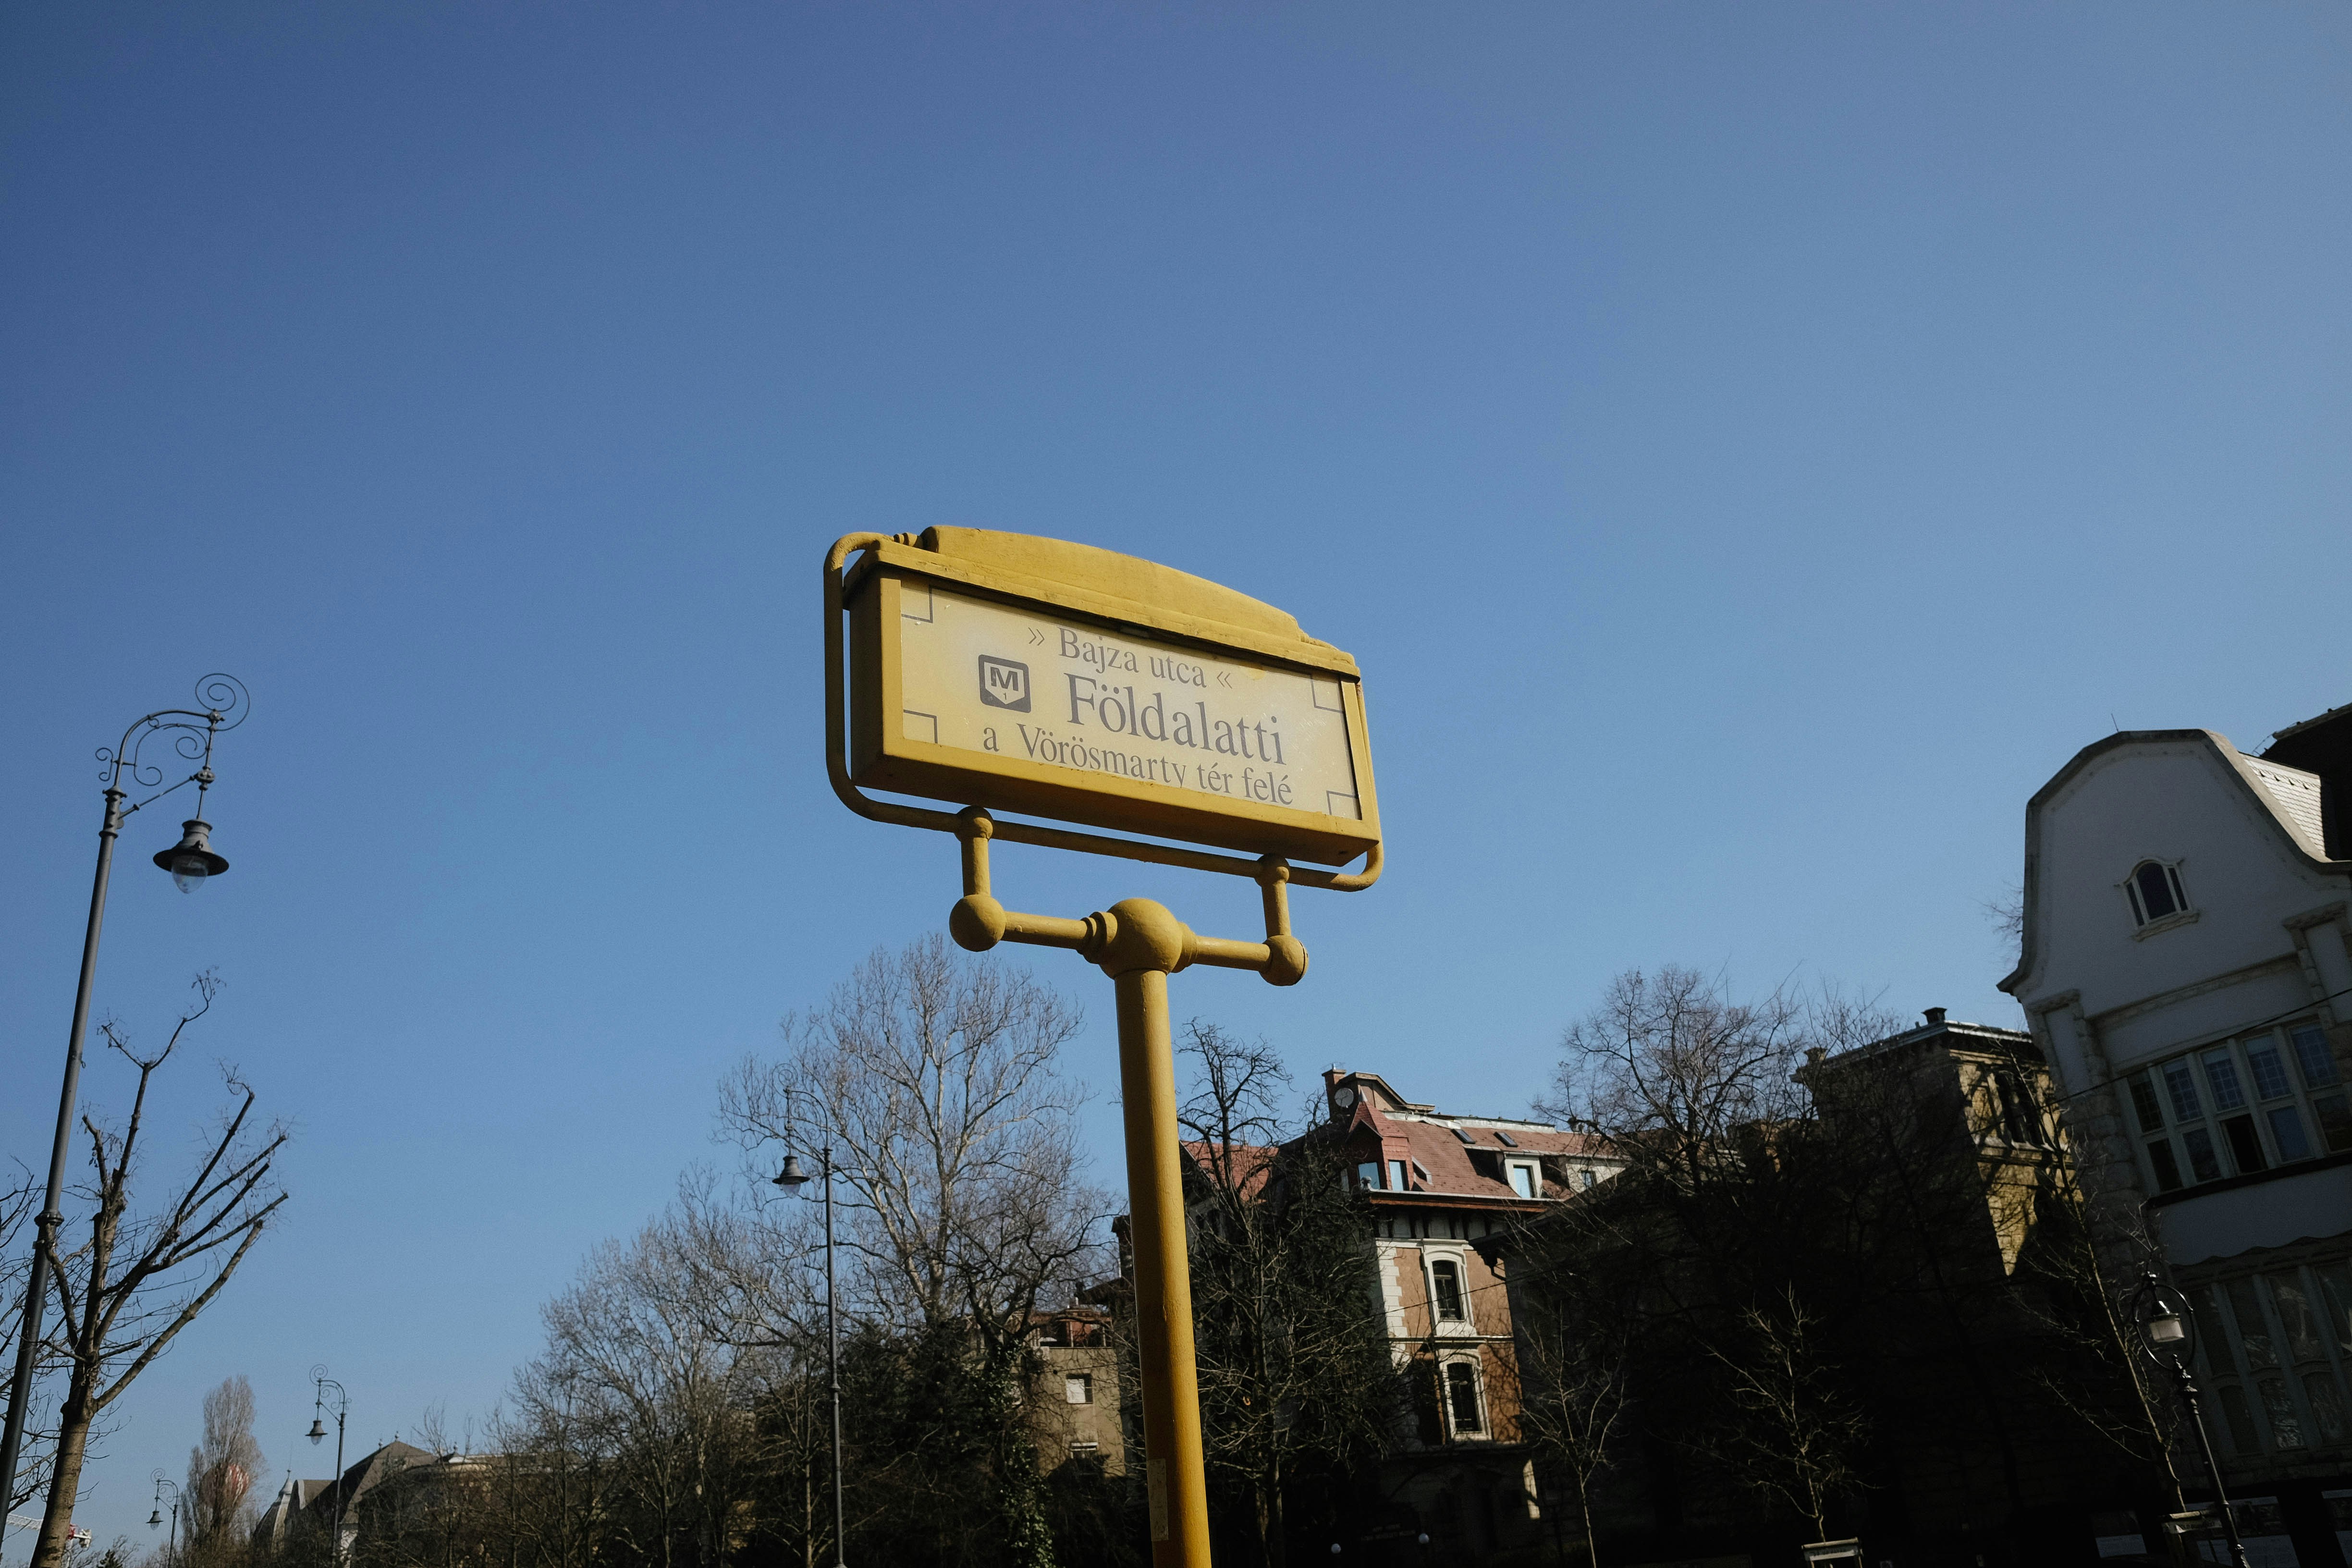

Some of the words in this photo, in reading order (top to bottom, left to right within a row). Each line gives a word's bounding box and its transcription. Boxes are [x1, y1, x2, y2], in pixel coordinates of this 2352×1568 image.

[990, 666, 1019, 692] M
[1057, 626, 1139, 674] Bajza
[1149, 655, 1207, 688] utca
[1003, 692, 1007, 700] 1
[1063, 672, 1287, 765] Földalatti
[983, 727, 1000, 752] a
[1016, 723, 1187, 788] Vörösmarty
[1197, 762, 1233, 794] tér
[1241, 767, 1293, 805] felé
